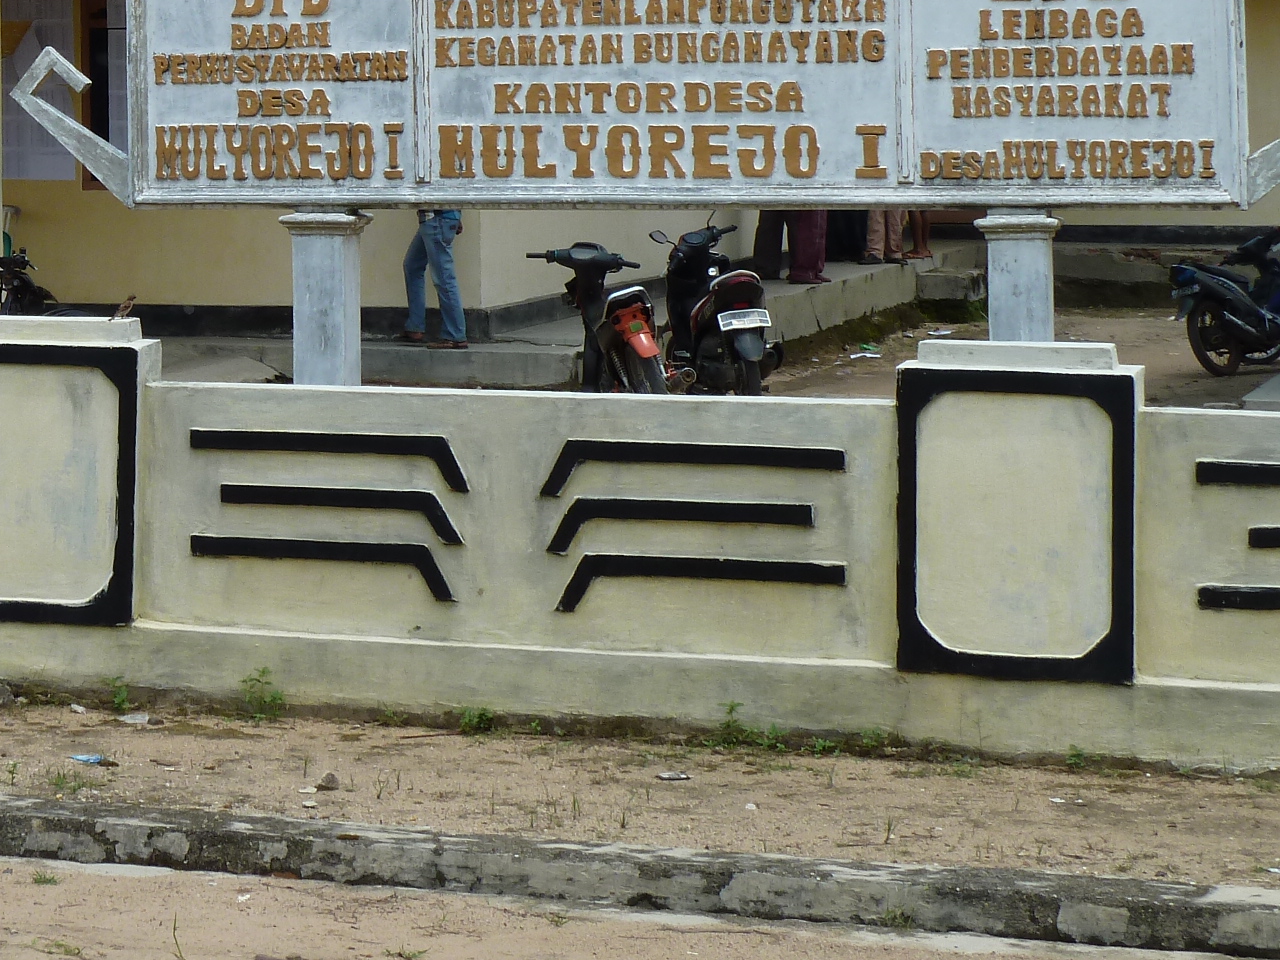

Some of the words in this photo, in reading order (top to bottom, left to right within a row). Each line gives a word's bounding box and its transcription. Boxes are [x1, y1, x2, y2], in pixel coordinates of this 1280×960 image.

[230, 21, 332, 50] BADAN
[978, 7, 1145, 40] LEMBAGA
[434, 34, 624, 68] KECAMATAN
[632, 30, 887, 64] BUNGAMAYANG
[926, 43, 1195, 79] PEMBERDAYAAN
[153, 50, 410, 85] PERMUSYAWARATAN
[236, 88, 332, 118] DESA
[951, 83, 1171, 118] MASYARAKAT
[154, 122, 374, 180] MULYOREJO
[383, 122, 405, 180] I
[438, 124, 821, 179] MULYOREJO
[855, 124, 888, 179] I
